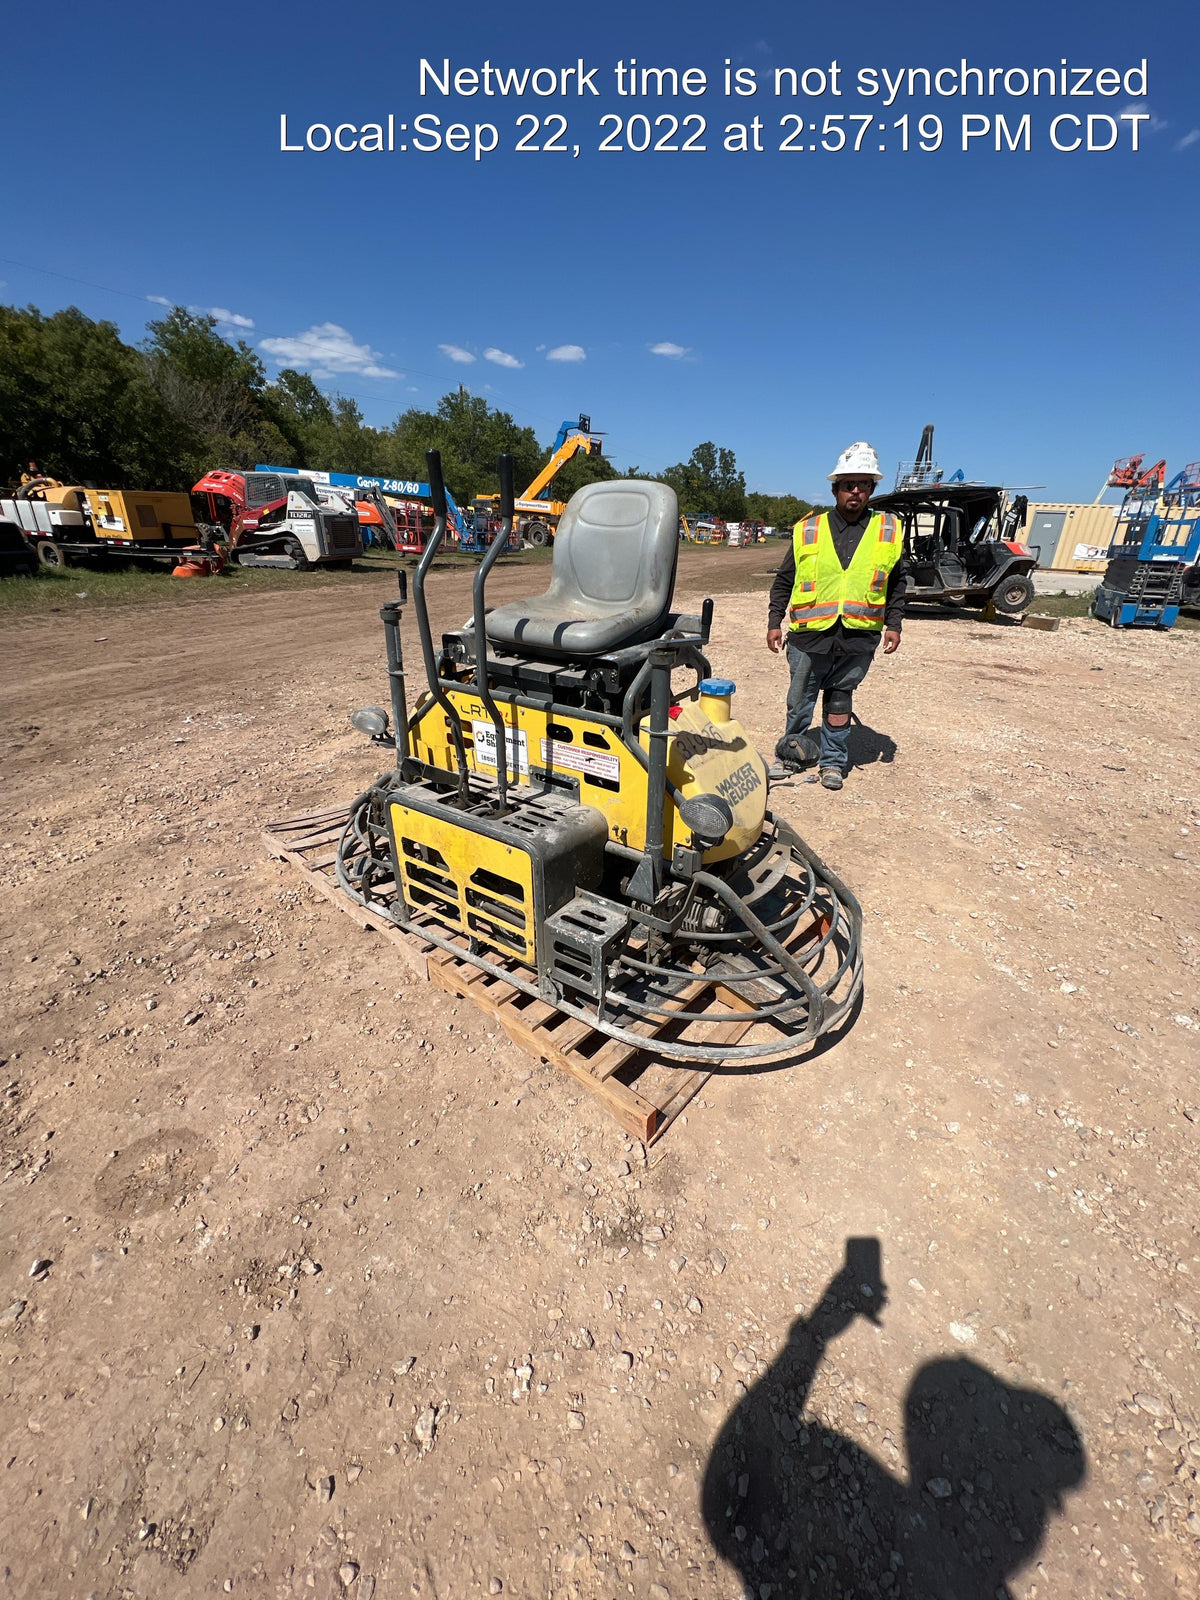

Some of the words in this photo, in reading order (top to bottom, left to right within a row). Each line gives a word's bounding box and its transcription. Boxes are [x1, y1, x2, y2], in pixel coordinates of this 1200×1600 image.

[356, 476, 380, 489] Genie
[383, 479, 420, 494] Z-80/60
[715, 761, 756, 798] WACKER
